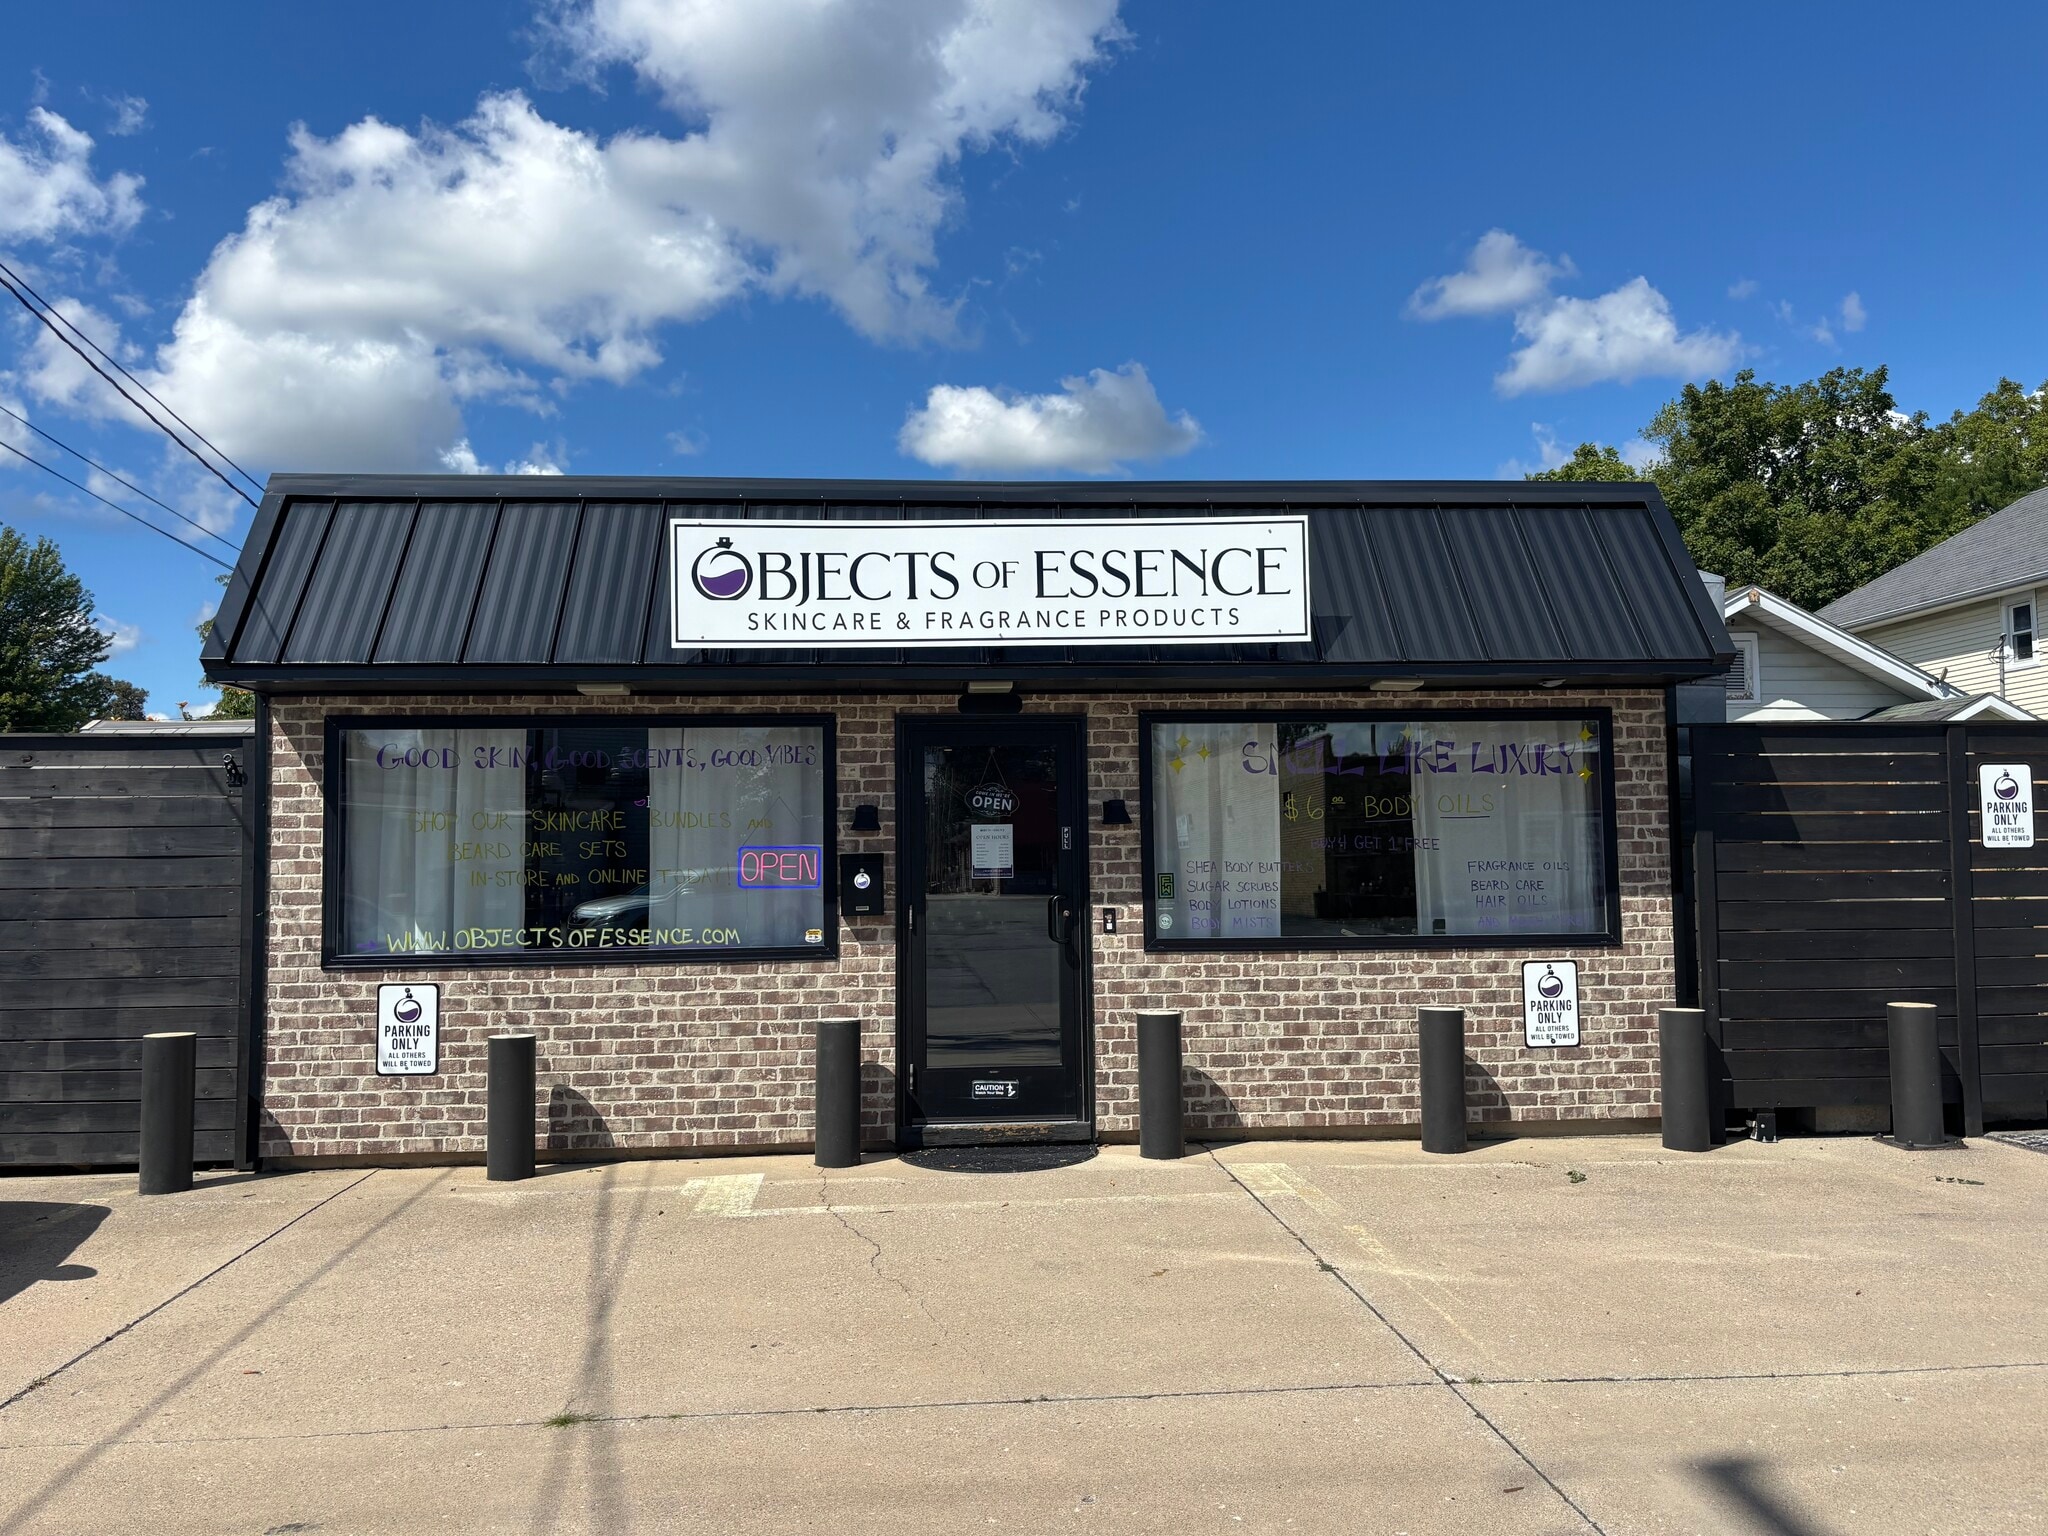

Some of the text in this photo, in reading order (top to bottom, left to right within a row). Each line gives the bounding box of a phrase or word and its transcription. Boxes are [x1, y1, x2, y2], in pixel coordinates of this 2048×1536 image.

[691, 538, 1292, 607] OBJECTS OF ESSENCE
[748, 607, 1241, 631] SKINCARE & FRAGRANCE PRODUCTS
[766, 745, 817, 766] VIBES
[1379, 741, 1457, 776] LIKE
[1471, 741, 1577, 776] LUXURY
[972, 795, 1012, 811] OPEN
[1364, 795, 1420, 819] BODY
[1437, 793, 1495, 814] OILS
[1986, 801, 2028, 813] PARKING
[408, 811, 459, 833] SHOP
[472, 812, 513, 832] OUR
[532, 809, 626, 832] SKINCARE
[650, 809, 732, 829] BUNDLES
[1994, 814, 2018, 825] ONLY
[1354, 836, 1381, 850] GET
[1405, 838, 1440, 850] FREE
[447, 840, 627, 861] BEARD CARE SETS
[741, 852, 817, 882] OPEN
[1186, 861, 1217, 874] SHEA
[1225, 861, 1253, 874] BODY
[1467, 860, 1570, 873] FRAGRANCE OILS
[471, 870, 550, 887] IN-STORE
[556, 873, 580, 886] AND
[588, 869, 648, 885] ONLINE
[1186, 880, 1279, 893] SUGAR SCRUBS
[1471, 879, 1545, 892] BEARD CARE
[1189, 899, 1278, 911] BODY LOTIONS
[1476, 895, 1548, 908] HAIR OILS
[1191, 917, 1274, 930] BODY MISTS
[1530, 1000, 1572, 1012] PARKING
[1537, 1012, 1563, 1024] ONLY
[384, 1025, 430, 1037] PARKING
[391, 1038, 419, 1050] ONLY
